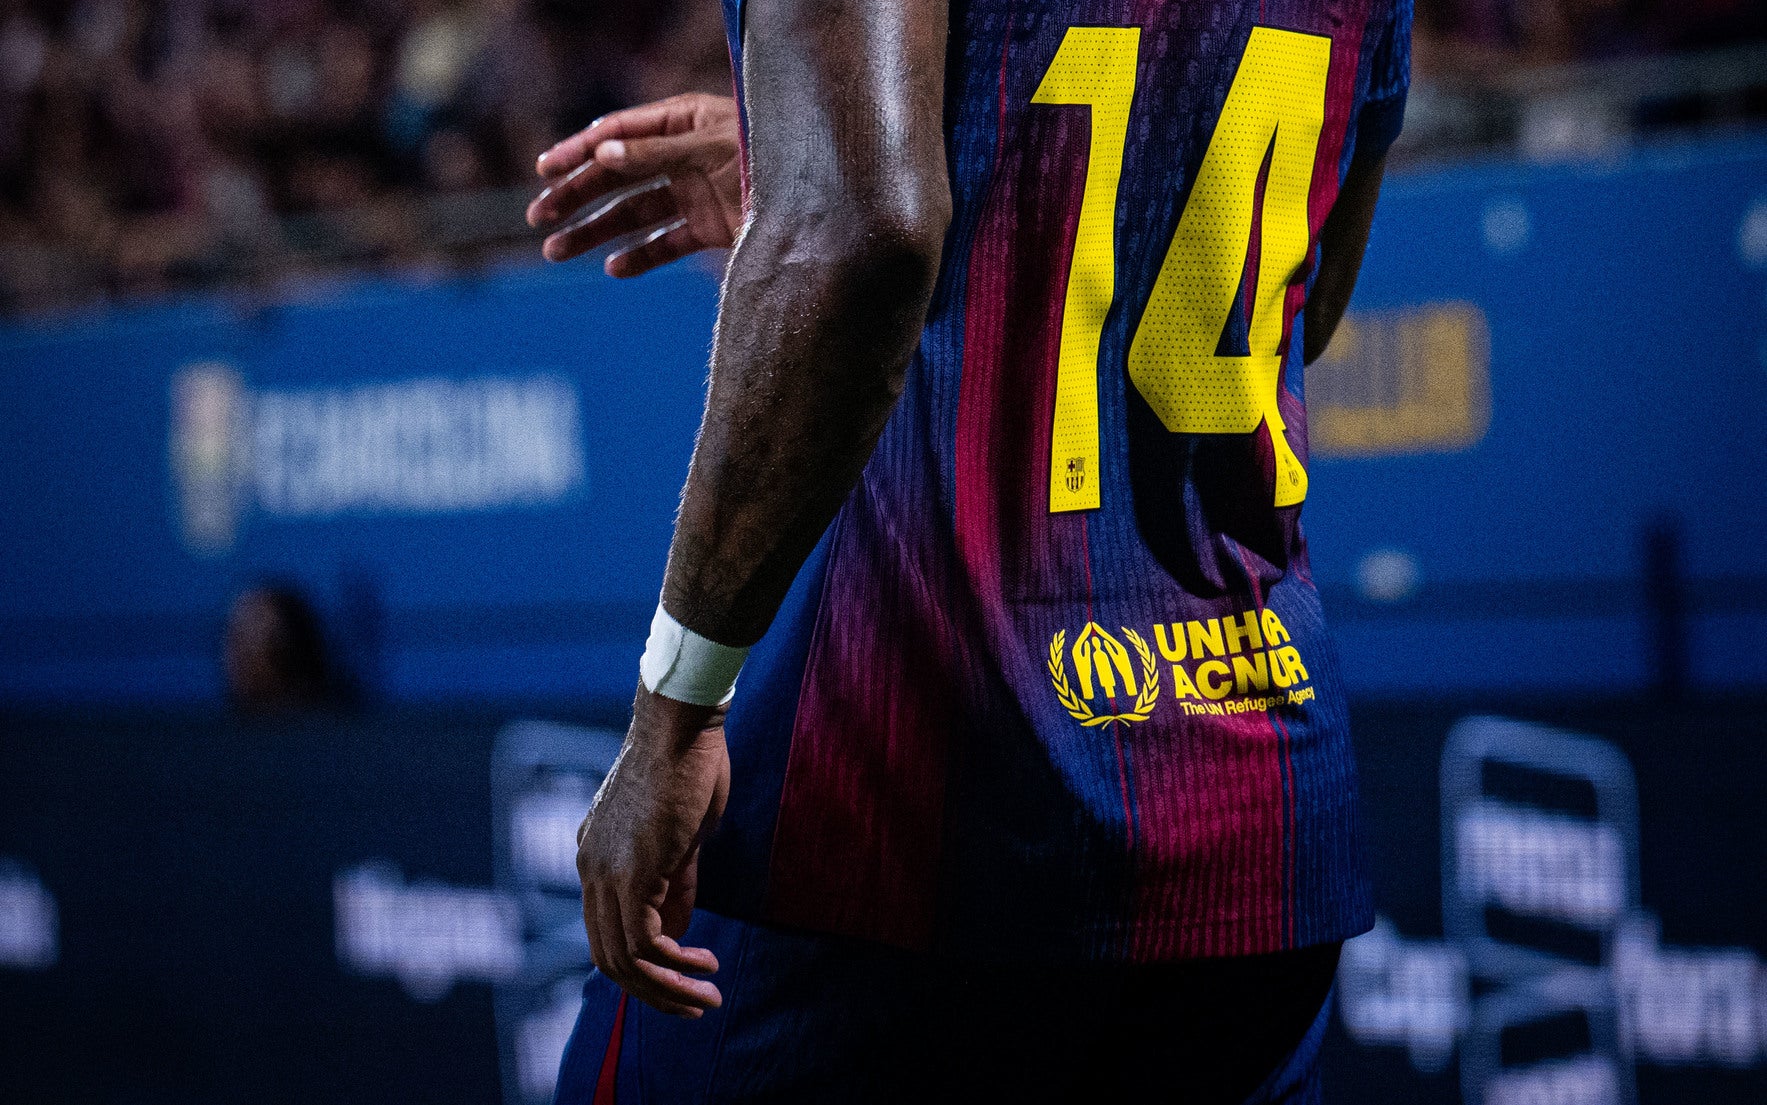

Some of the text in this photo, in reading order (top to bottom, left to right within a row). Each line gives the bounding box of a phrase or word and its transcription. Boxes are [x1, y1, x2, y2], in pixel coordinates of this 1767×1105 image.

[1030, 26, 1332, 513] 14
[1172, 645, 1310, 700] ACNUR
[1180, 701, 1206, 716] The
[1204, 703, 1224, 716] UN
[1224, 696, 1285, 715] Refugee
